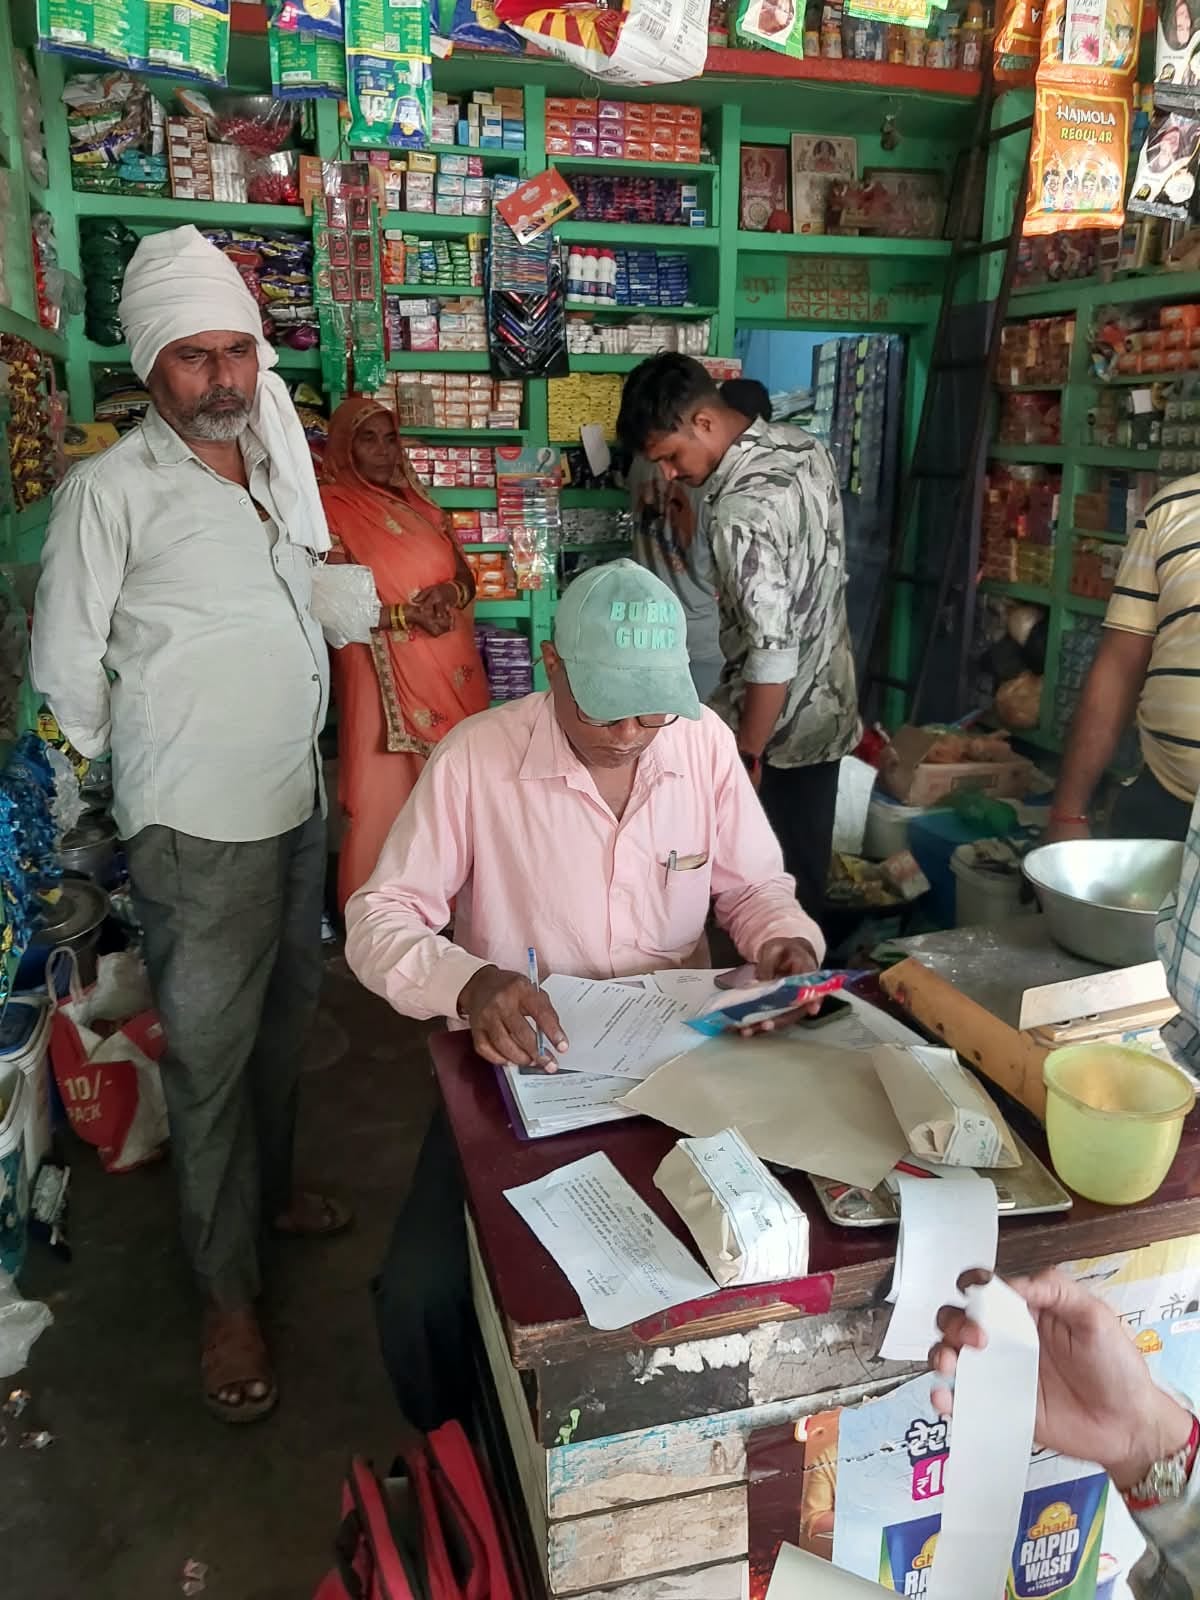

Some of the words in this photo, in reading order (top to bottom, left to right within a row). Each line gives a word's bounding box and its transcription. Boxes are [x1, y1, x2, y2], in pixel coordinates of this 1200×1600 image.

[1056, 105, 1116, 126] HAJMOLA
[1061, 127, 1113, 144] REGULAR
[64, 1069, 112, 1101] 10/-
[916, 1459, 946, 1496] ₹1
[1028, 1514, 1078, 1540] Ghadi
[1020, 1528, 1080, 1566] RAPID
[1025, 1554, 1071, 1583] WASH
